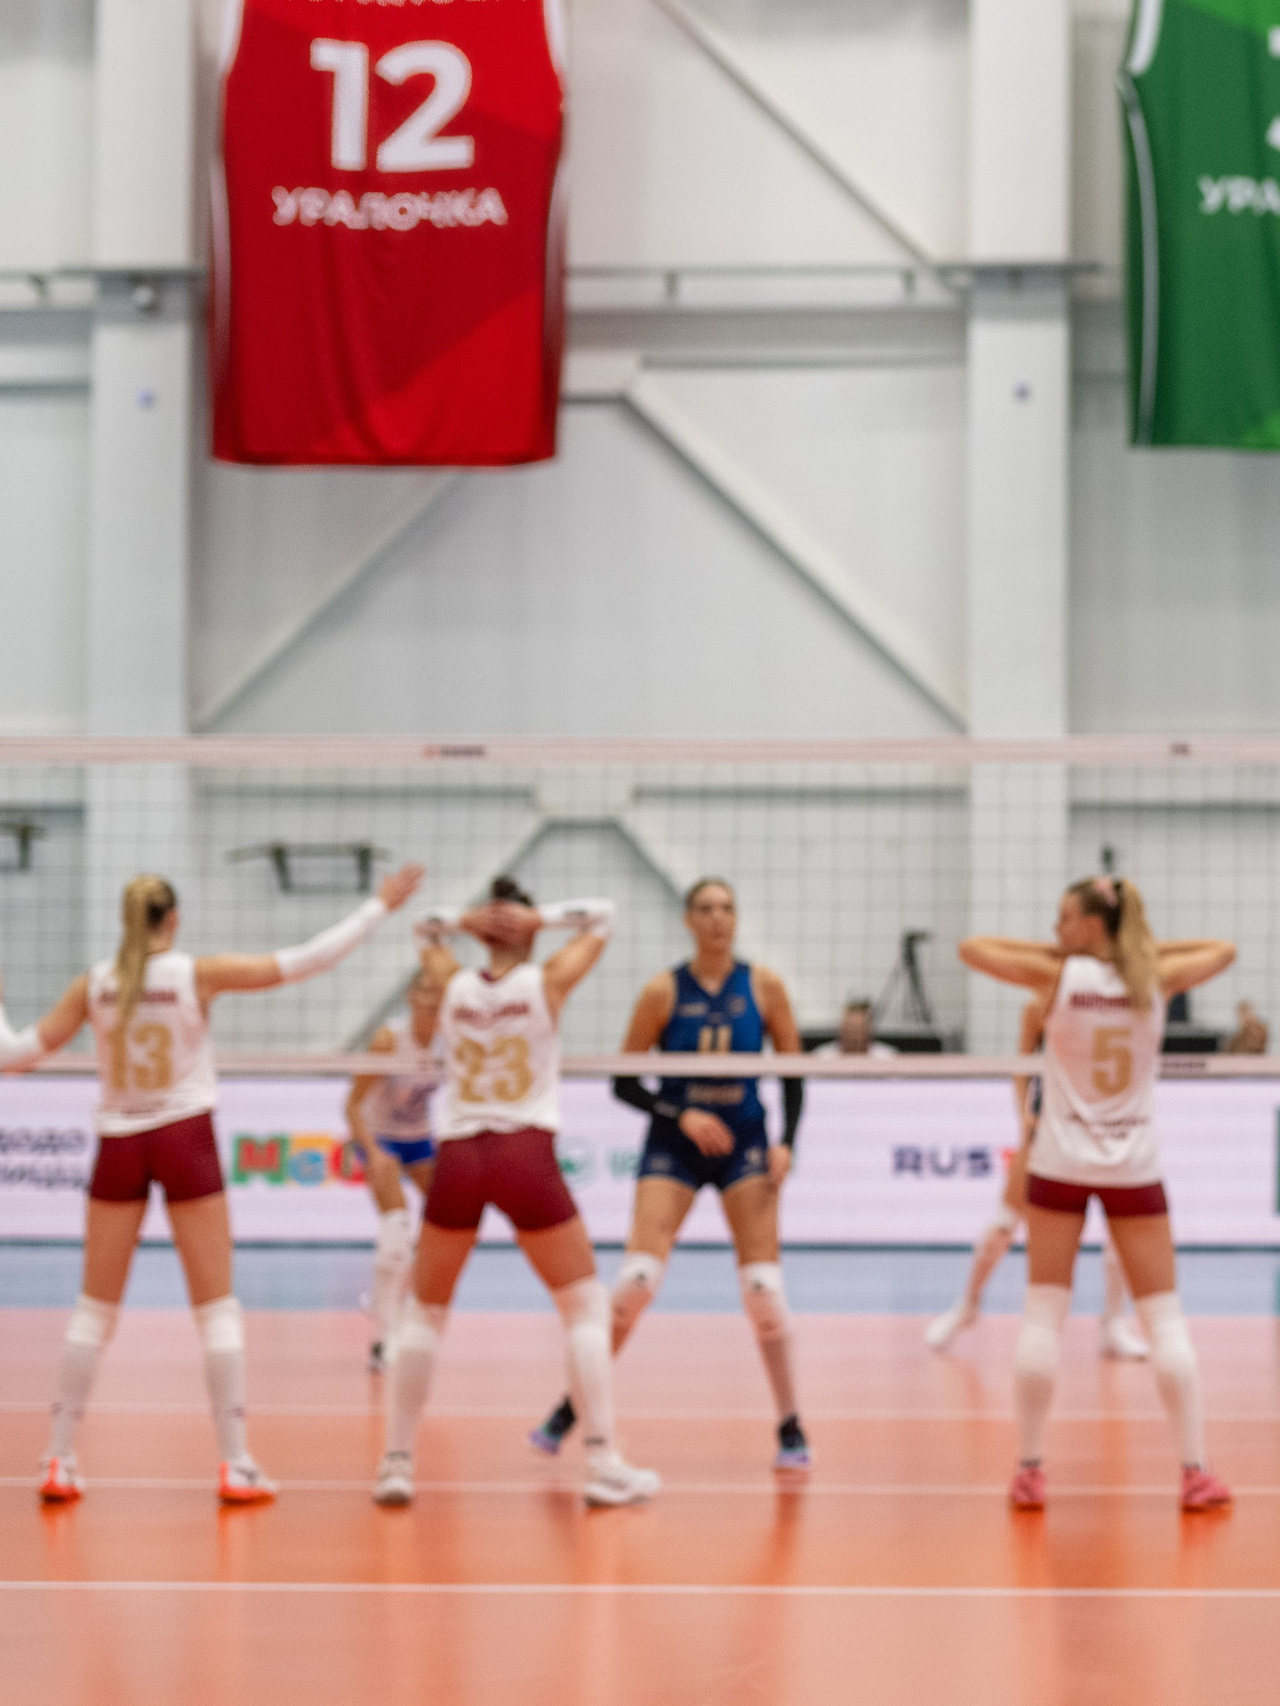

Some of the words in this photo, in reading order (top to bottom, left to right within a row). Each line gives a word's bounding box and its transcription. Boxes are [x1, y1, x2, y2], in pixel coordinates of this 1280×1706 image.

[310, 38, 475, 172] 12
[271, 186, 509, 231] УРАЛОЧКА
[107, 1022, 173, 1092] 13
[455, 1035, 533, 1103] 23
[1093, 1026, 1132, 1096] 5
